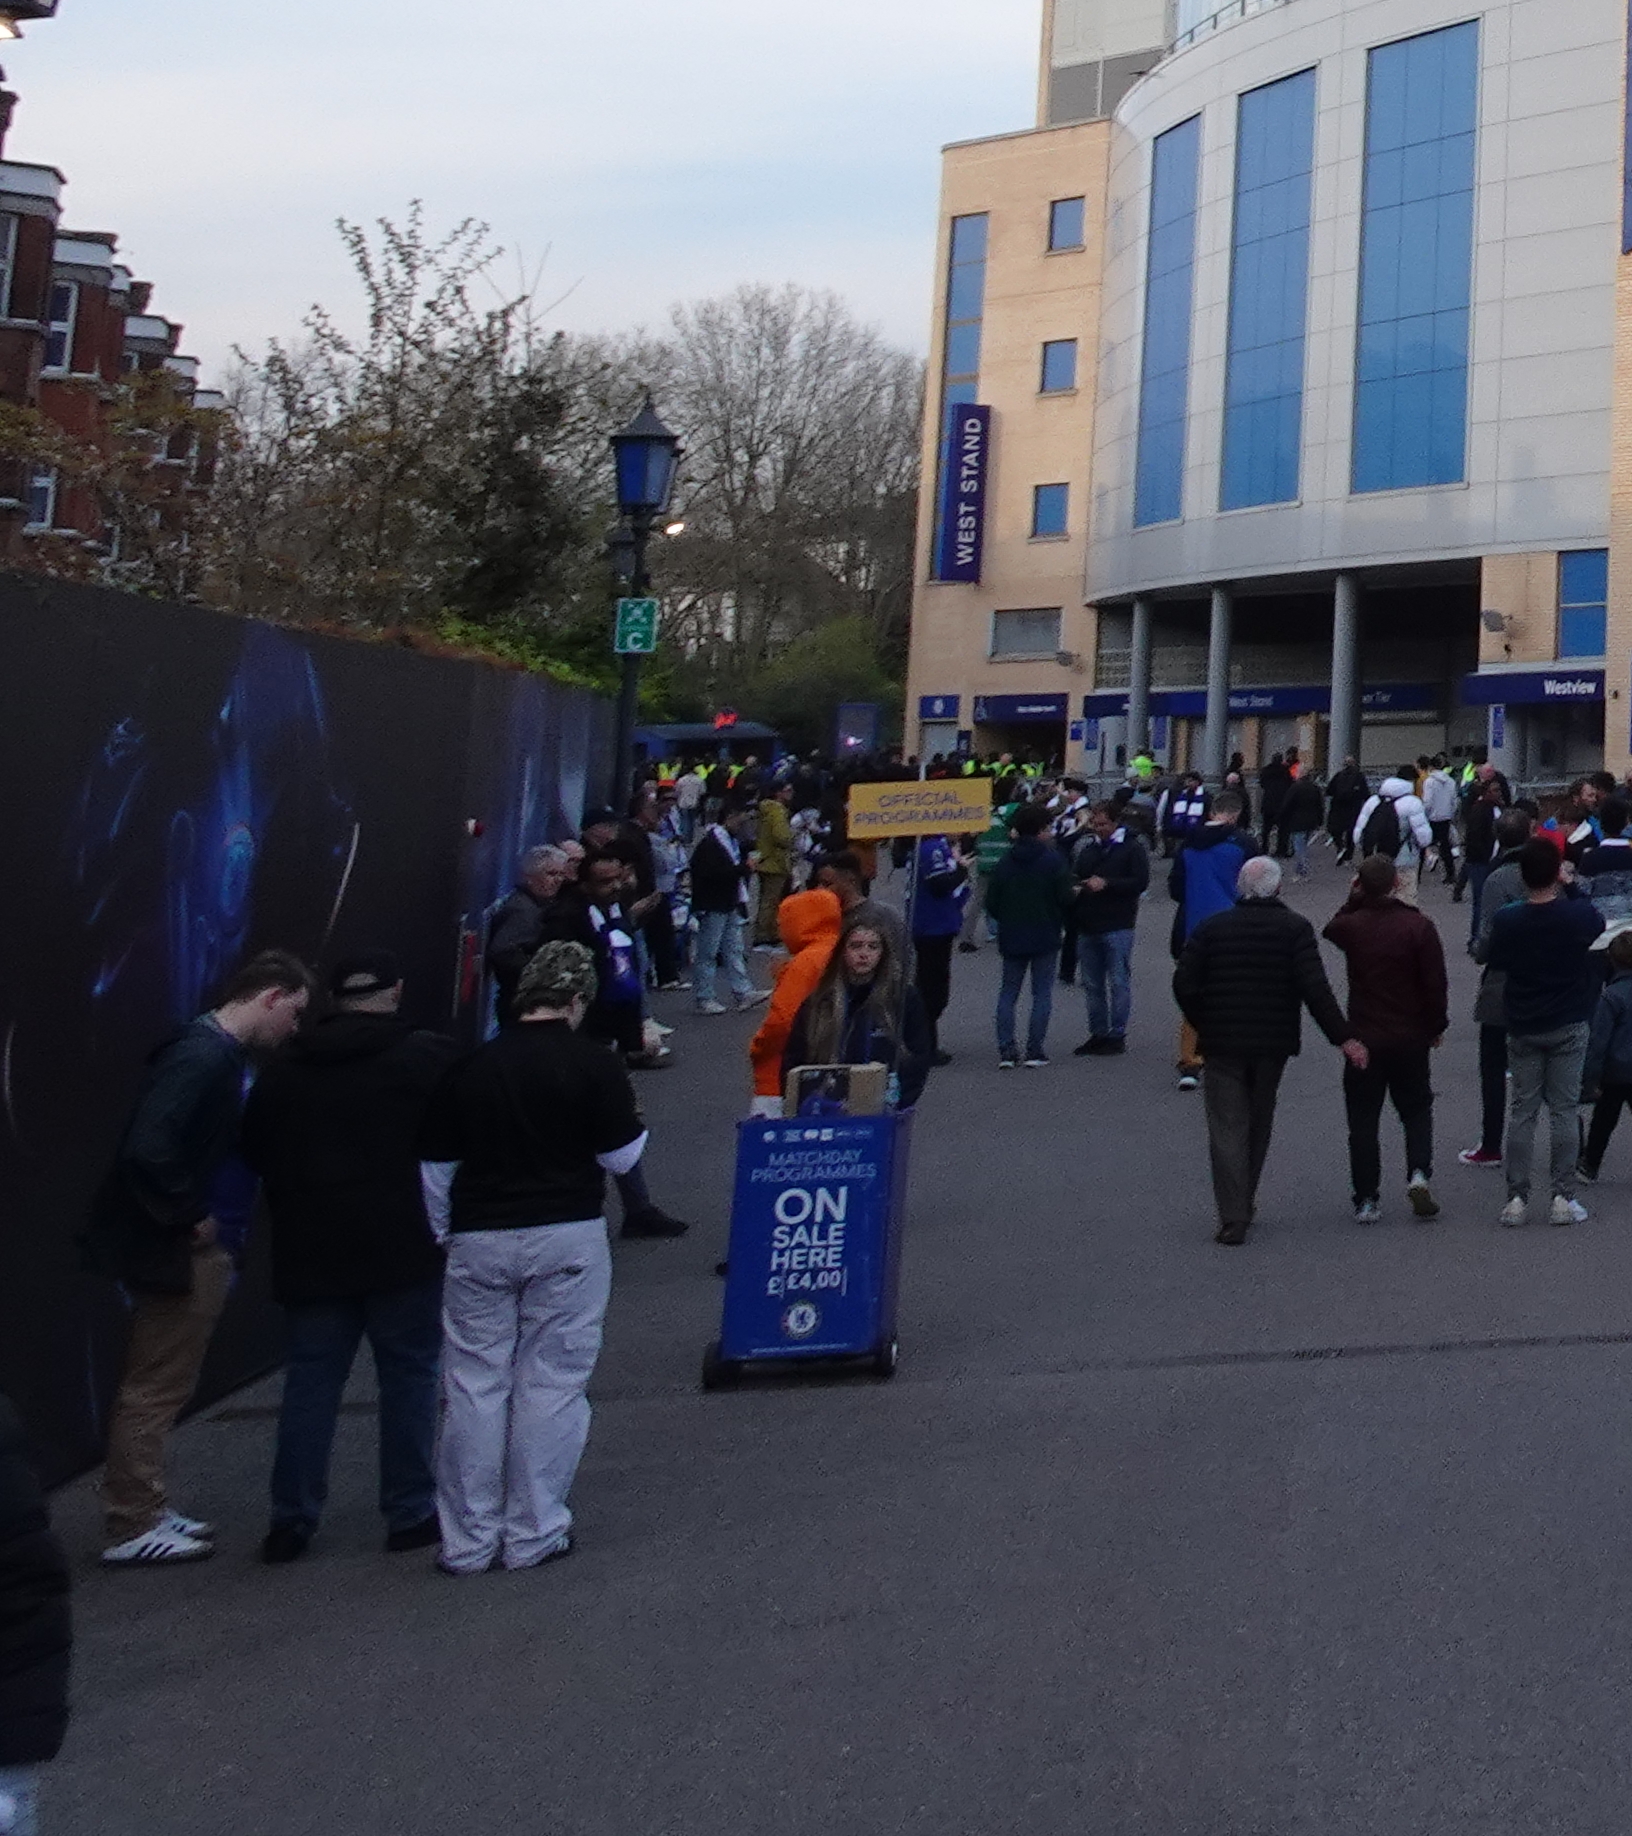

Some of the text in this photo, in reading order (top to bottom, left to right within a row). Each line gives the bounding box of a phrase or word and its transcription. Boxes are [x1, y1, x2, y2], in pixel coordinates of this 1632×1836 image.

[956, 416, 982, 567] WEST STAND
[1544, 679, 1598, 696] Westview
[879, 791, 962, 808] OFFICIAL
[853, 805, 985, 824] PROGRAMMES
[769, 1148, 863, 1167] MATCHDAY
[751, 1163, 877, 1183] PROGRAMMES
[774, 1186, 848, 1225] ON
[772, 1223, 846, 1249] SALE
[770, 1247, 844, 1273] HERE
